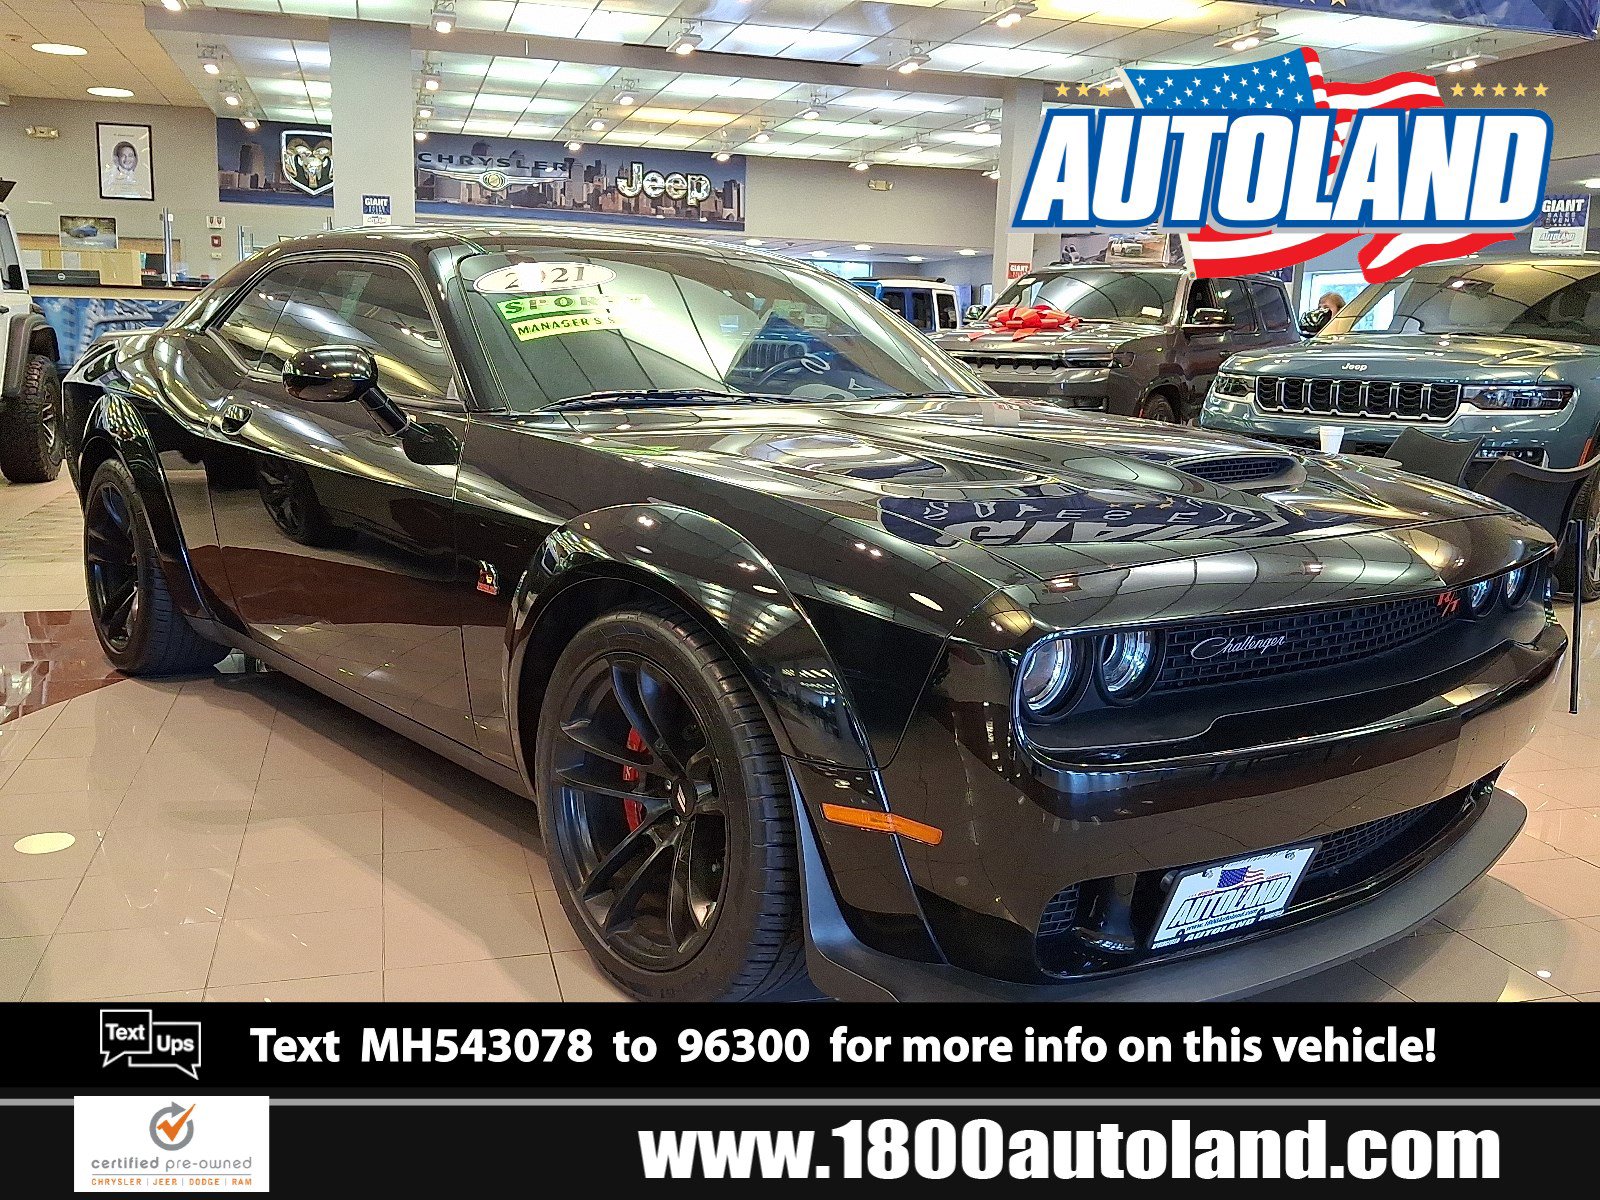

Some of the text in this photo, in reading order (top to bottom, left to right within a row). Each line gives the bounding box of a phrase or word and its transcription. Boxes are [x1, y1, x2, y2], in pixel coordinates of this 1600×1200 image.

[418, 152, 567, 172] CHRYSLER
[615, 160, 713, 206] Jeep
[1541, 198, 1585, 213] GIANT
[504, 266, 585, 290] 221
[1341, 362, 1368, 372] Jeep
[1436, 591, 1461, 618] R/T
[1190, 635, 1286, 660] Challenger
[1166, 874, 1292, 930] AUTOLAND
[1184, 917, 1257, 943] AUTOLAND
